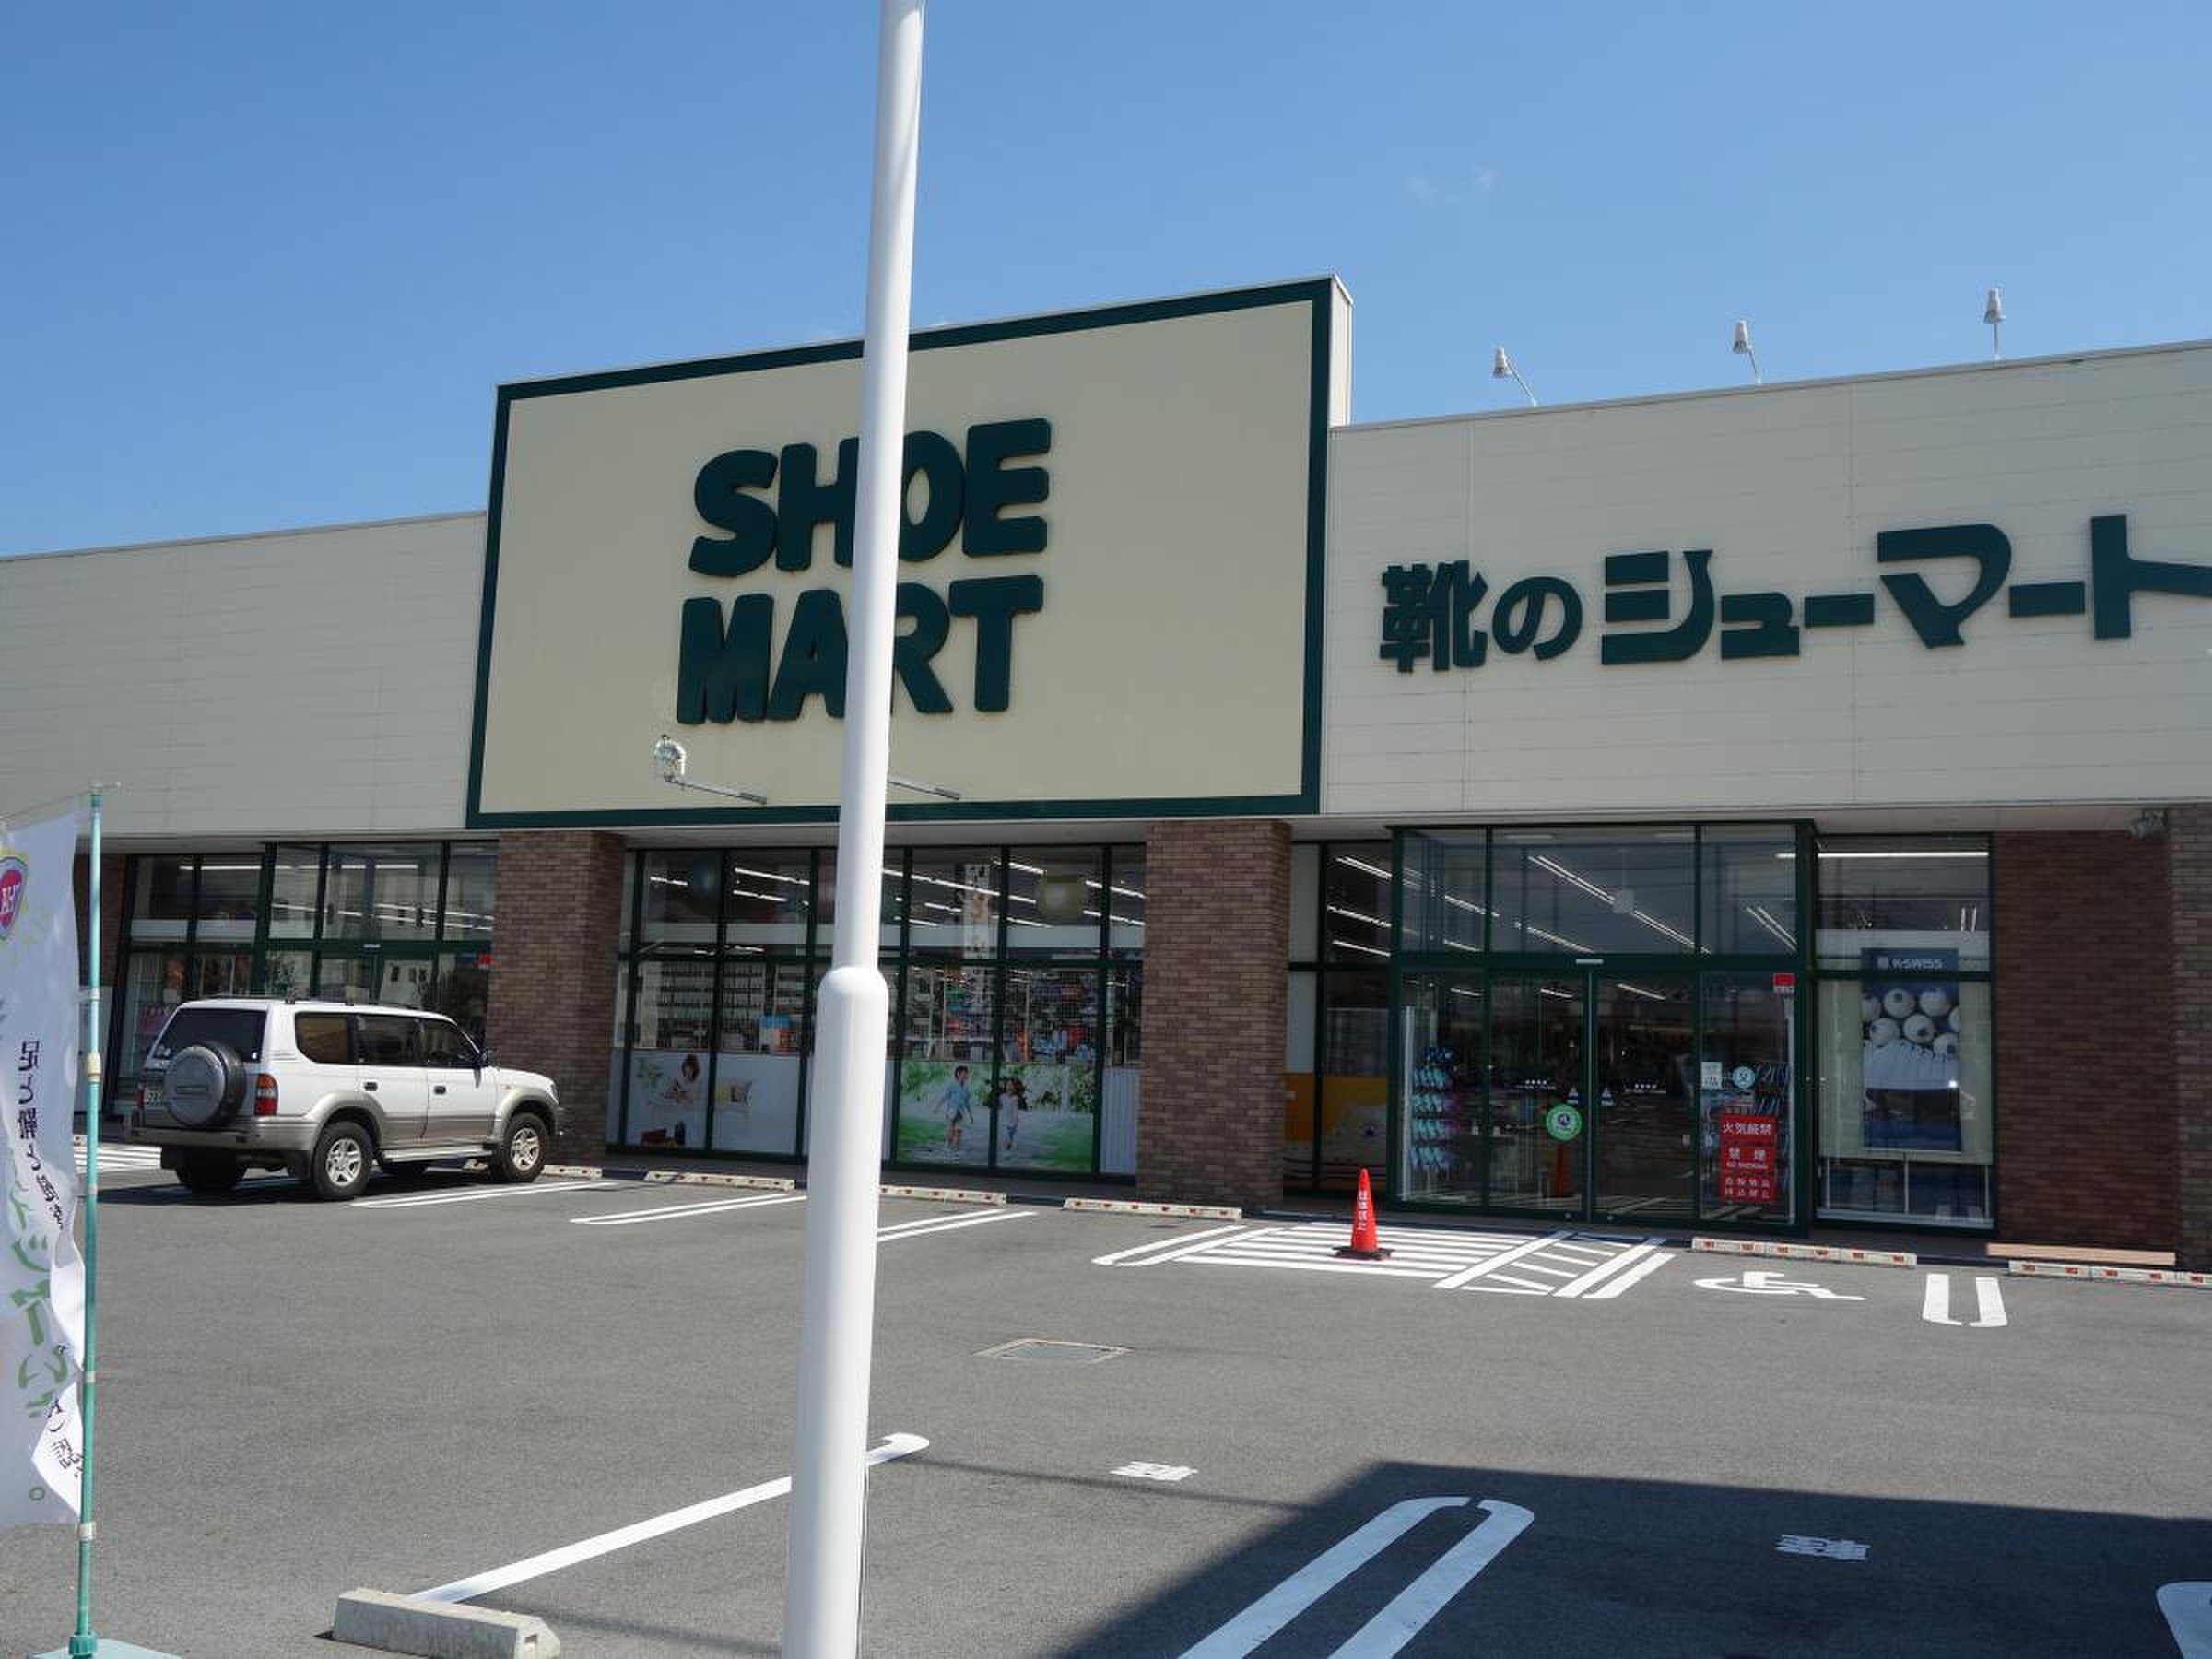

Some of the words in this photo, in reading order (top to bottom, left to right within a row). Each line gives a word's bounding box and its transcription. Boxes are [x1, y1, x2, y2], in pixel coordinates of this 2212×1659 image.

[688, 418, 1052, 577] SHOE
[677, 573, 1044, 724] MART
[1379, 513, 2212, 674] 靴のシューマート
